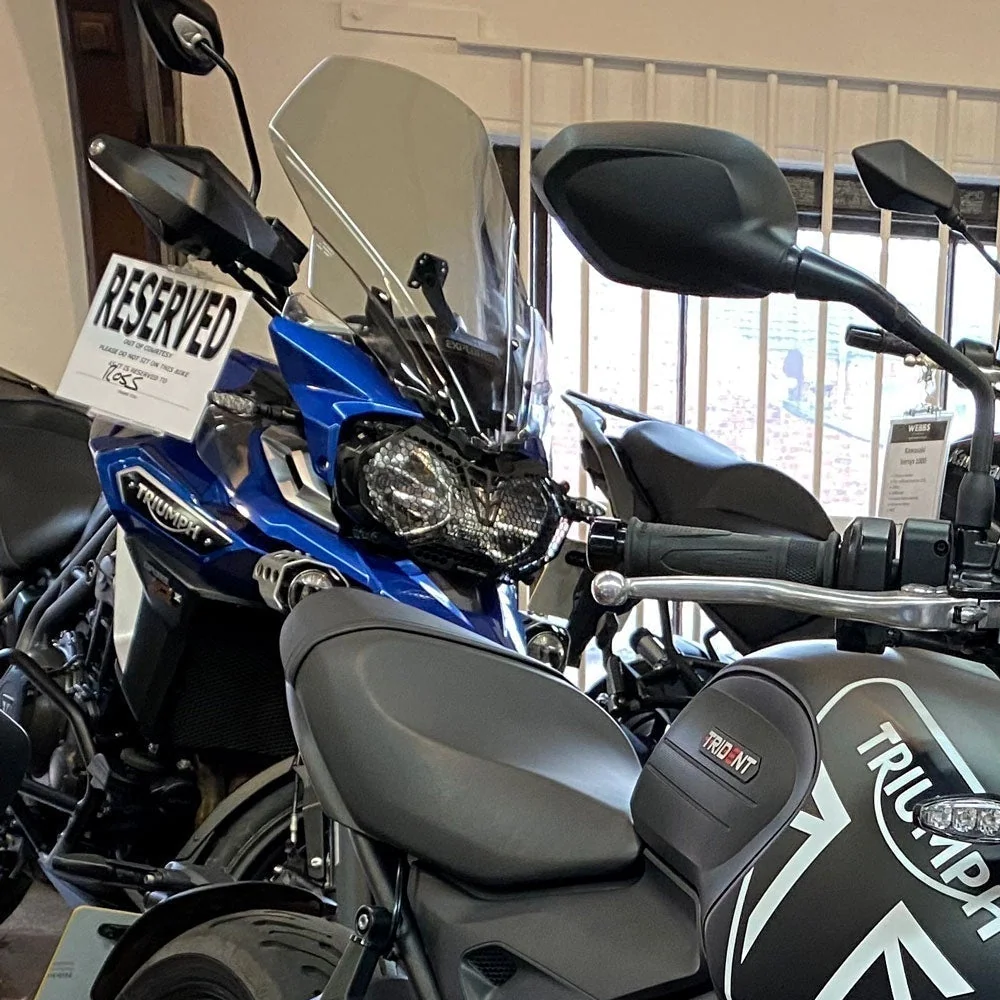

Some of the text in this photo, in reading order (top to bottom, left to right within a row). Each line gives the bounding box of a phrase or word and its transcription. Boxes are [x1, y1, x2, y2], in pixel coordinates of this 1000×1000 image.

[93, 263, 238, 361] RESERVED
[99, 344, 119, 355] PLEASE
[127, 352, 140, 361] NOT
[143, 344, 174, 358] COURTESY
[130, 366, 159, 381] RESERVED
[908, 423, 931, 432] WEBBS
[136, 482, 202, 540] TRIUMPH
[702, 730, 758, 775] TRIDENT
